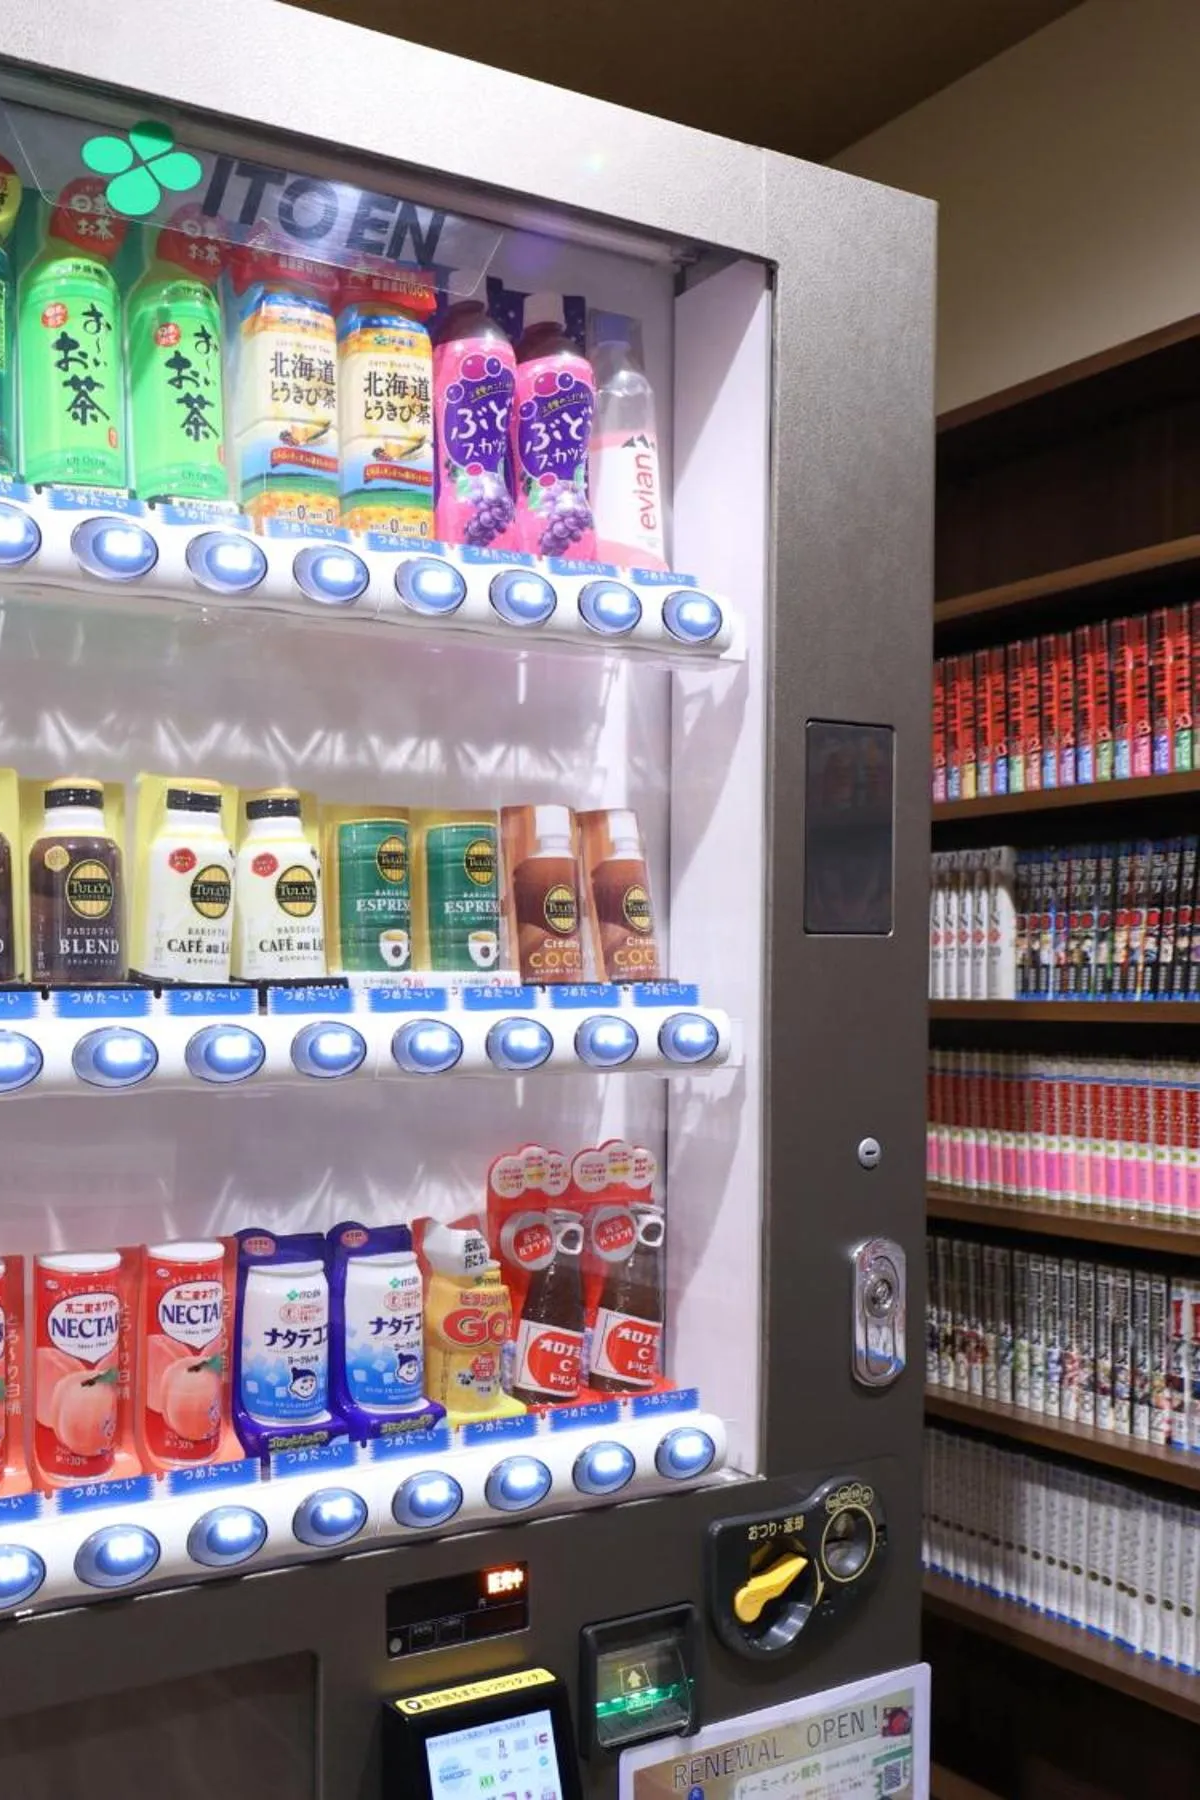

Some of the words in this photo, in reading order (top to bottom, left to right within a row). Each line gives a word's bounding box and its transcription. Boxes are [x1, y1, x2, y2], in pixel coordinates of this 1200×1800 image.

[270, 351, 336, 386] 北海道
[52, 331, 110, 426] お茶
[364, 371, 431, 402] 北海道
[164, 350, 220, 442] お茶
[525, 406, 593, 454] ぶど
[633, 451, 658, 531] evian
[59, 938, 120, 957] BLEND
[167, 937, 203, 954] CAFÉ
[258, 936, 295, 953] CAFÉ
[70, 992, 135, 1006] つめた〜い
[180, 990, 241, 1003] つめた〜い
[637, 1347, 650, 1361] C
[559, 1359, 573, 1373] C
[183, 1462, 244, 1481] つめた〜い
[72, 1478, 137, 1498] つめた〜い
[673, 1736, 785, 1789] RENEWAL
